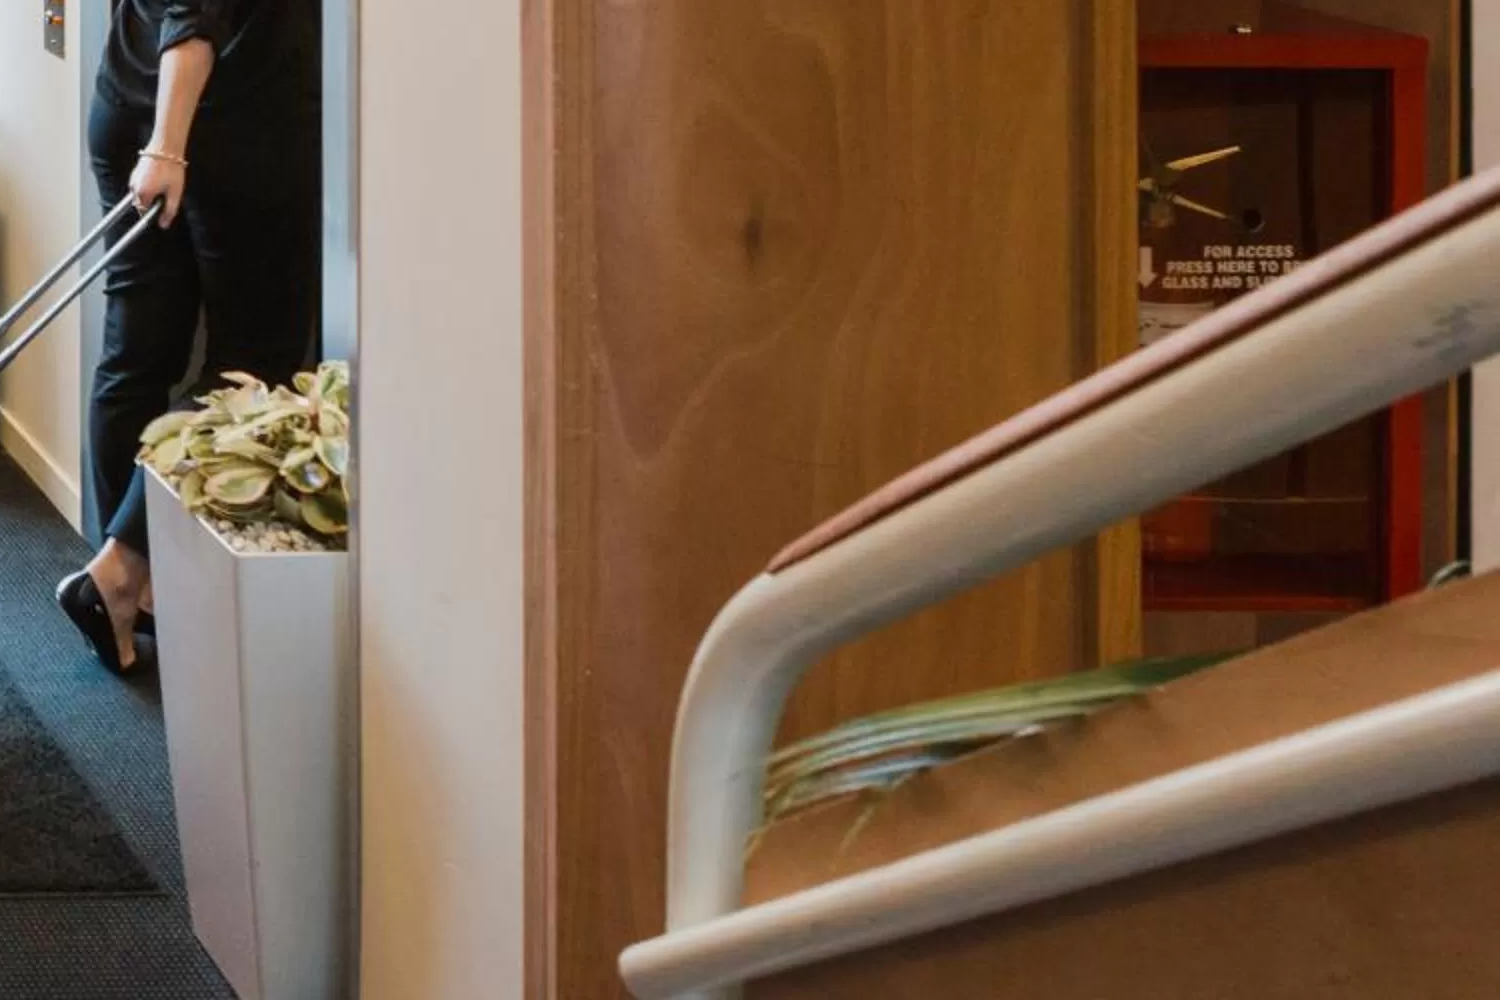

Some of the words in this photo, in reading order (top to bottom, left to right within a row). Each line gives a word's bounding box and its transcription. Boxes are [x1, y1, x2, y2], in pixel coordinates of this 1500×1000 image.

[1203, 245, 1232, 258] FOR
[1236, 245, 1294, 258] ACCESS
[1166, 261, 1213, 274] PRESS
[1217, 261, 1255, 273] HERE
[1259, 261, 1279, 273] TO
[1162, 276, 1209, 289] GLASS
[1212, 276, 1242, 289] AND
